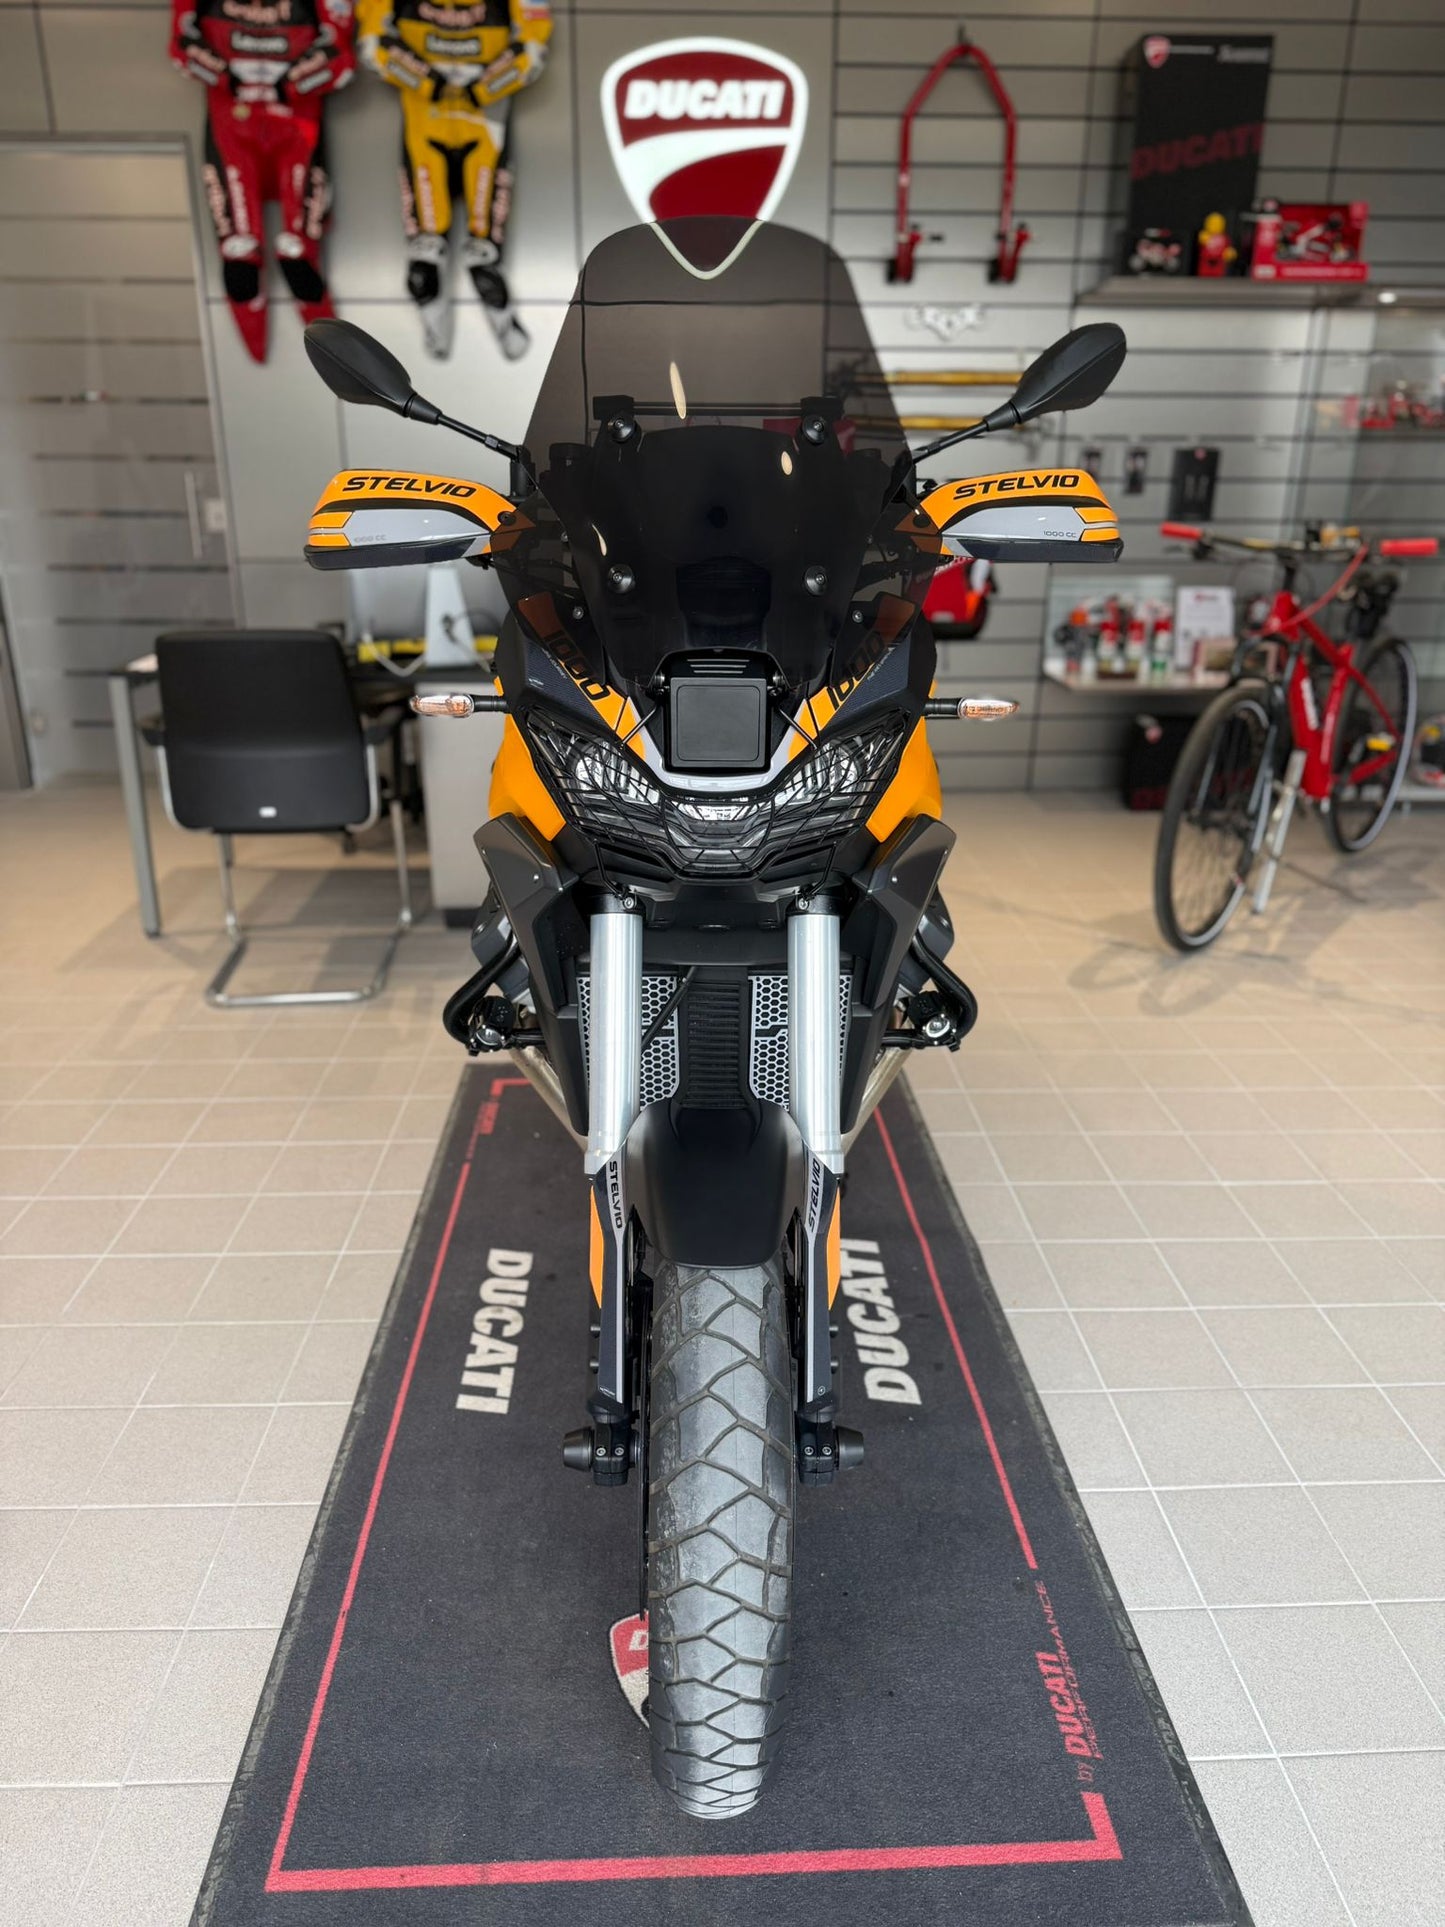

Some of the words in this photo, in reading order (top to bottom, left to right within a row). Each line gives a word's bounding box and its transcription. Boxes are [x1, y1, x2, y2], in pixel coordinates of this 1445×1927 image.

[624, 79, 786, 120] DUCATI
[1130, 121, 1266, 181] DUCATI
[342, 476, 477, 498] STELVIO
[953, 475, 1080, 500] STELVIO
[609, 1160, 623, 1229] STELVIO
[809, 1157, 821, 1233] STELVIO
[455, 1248, 534, 1414] DUCATI
[840, 1238, 922, 1405] DUCATI
[1035, 1651, 1093, 1758] DUCATI
